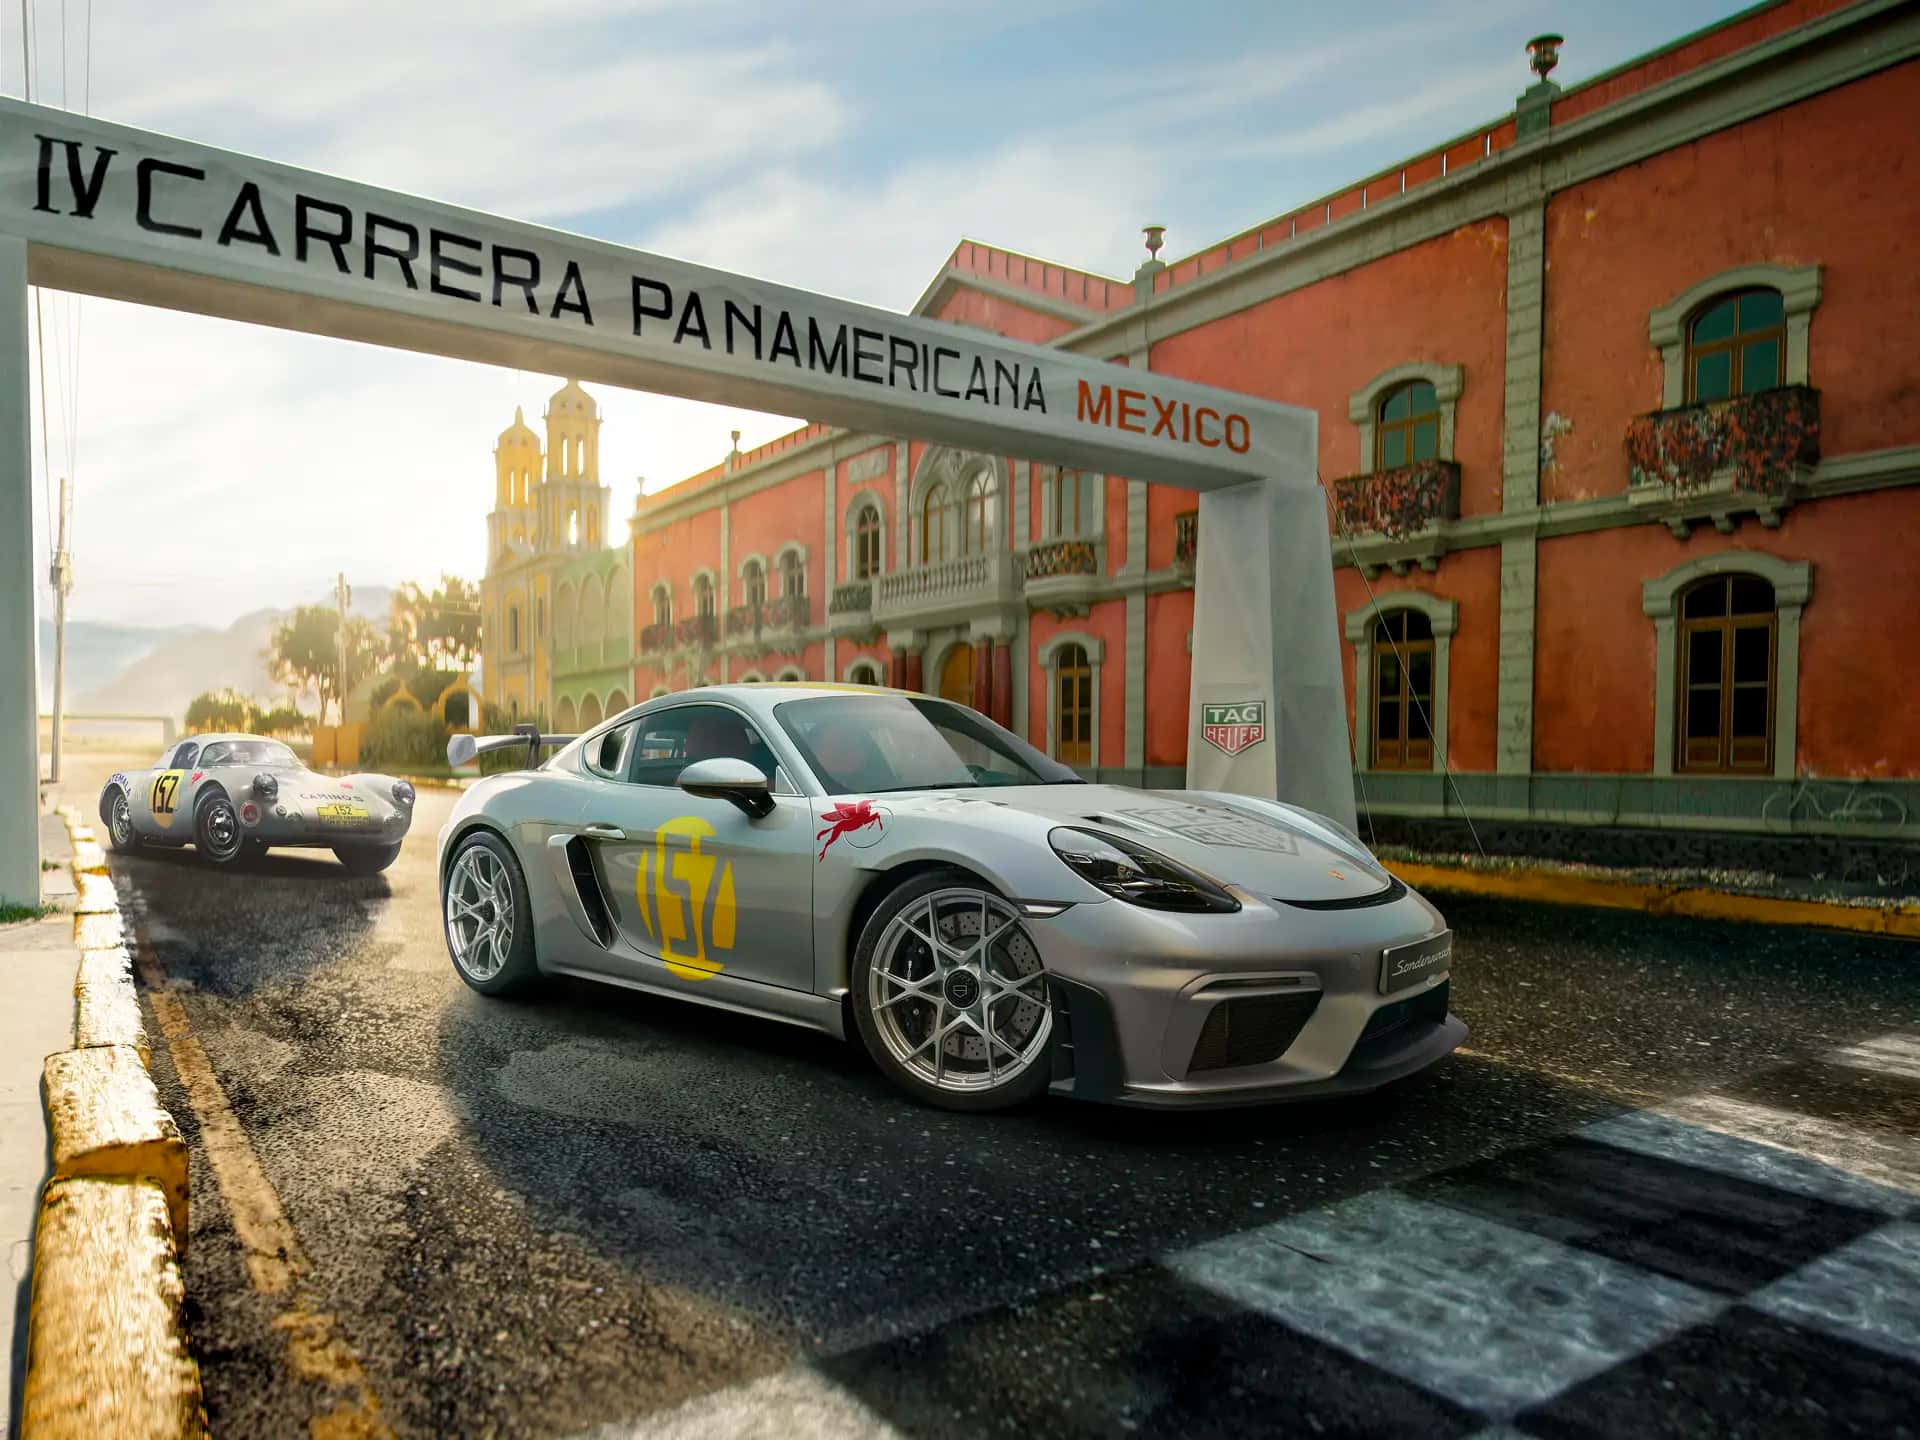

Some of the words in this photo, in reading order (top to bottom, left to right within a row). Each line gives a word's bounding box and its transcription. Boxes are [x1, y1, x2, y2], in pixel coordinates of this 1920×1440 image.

[31, 133, 118, 220] IV
[135, 157, 594, 326] CARRERA
[631, 274, 1047, 415] PANAMERICANA
[1077, 380, 1251, 454] MEXICO
[1208, 706, 1258, 723] TAG
[1206, 727, 1260, 751] HEUER
[152, 775, 180, 814] 152
[333, 805, 353, 816] 152
